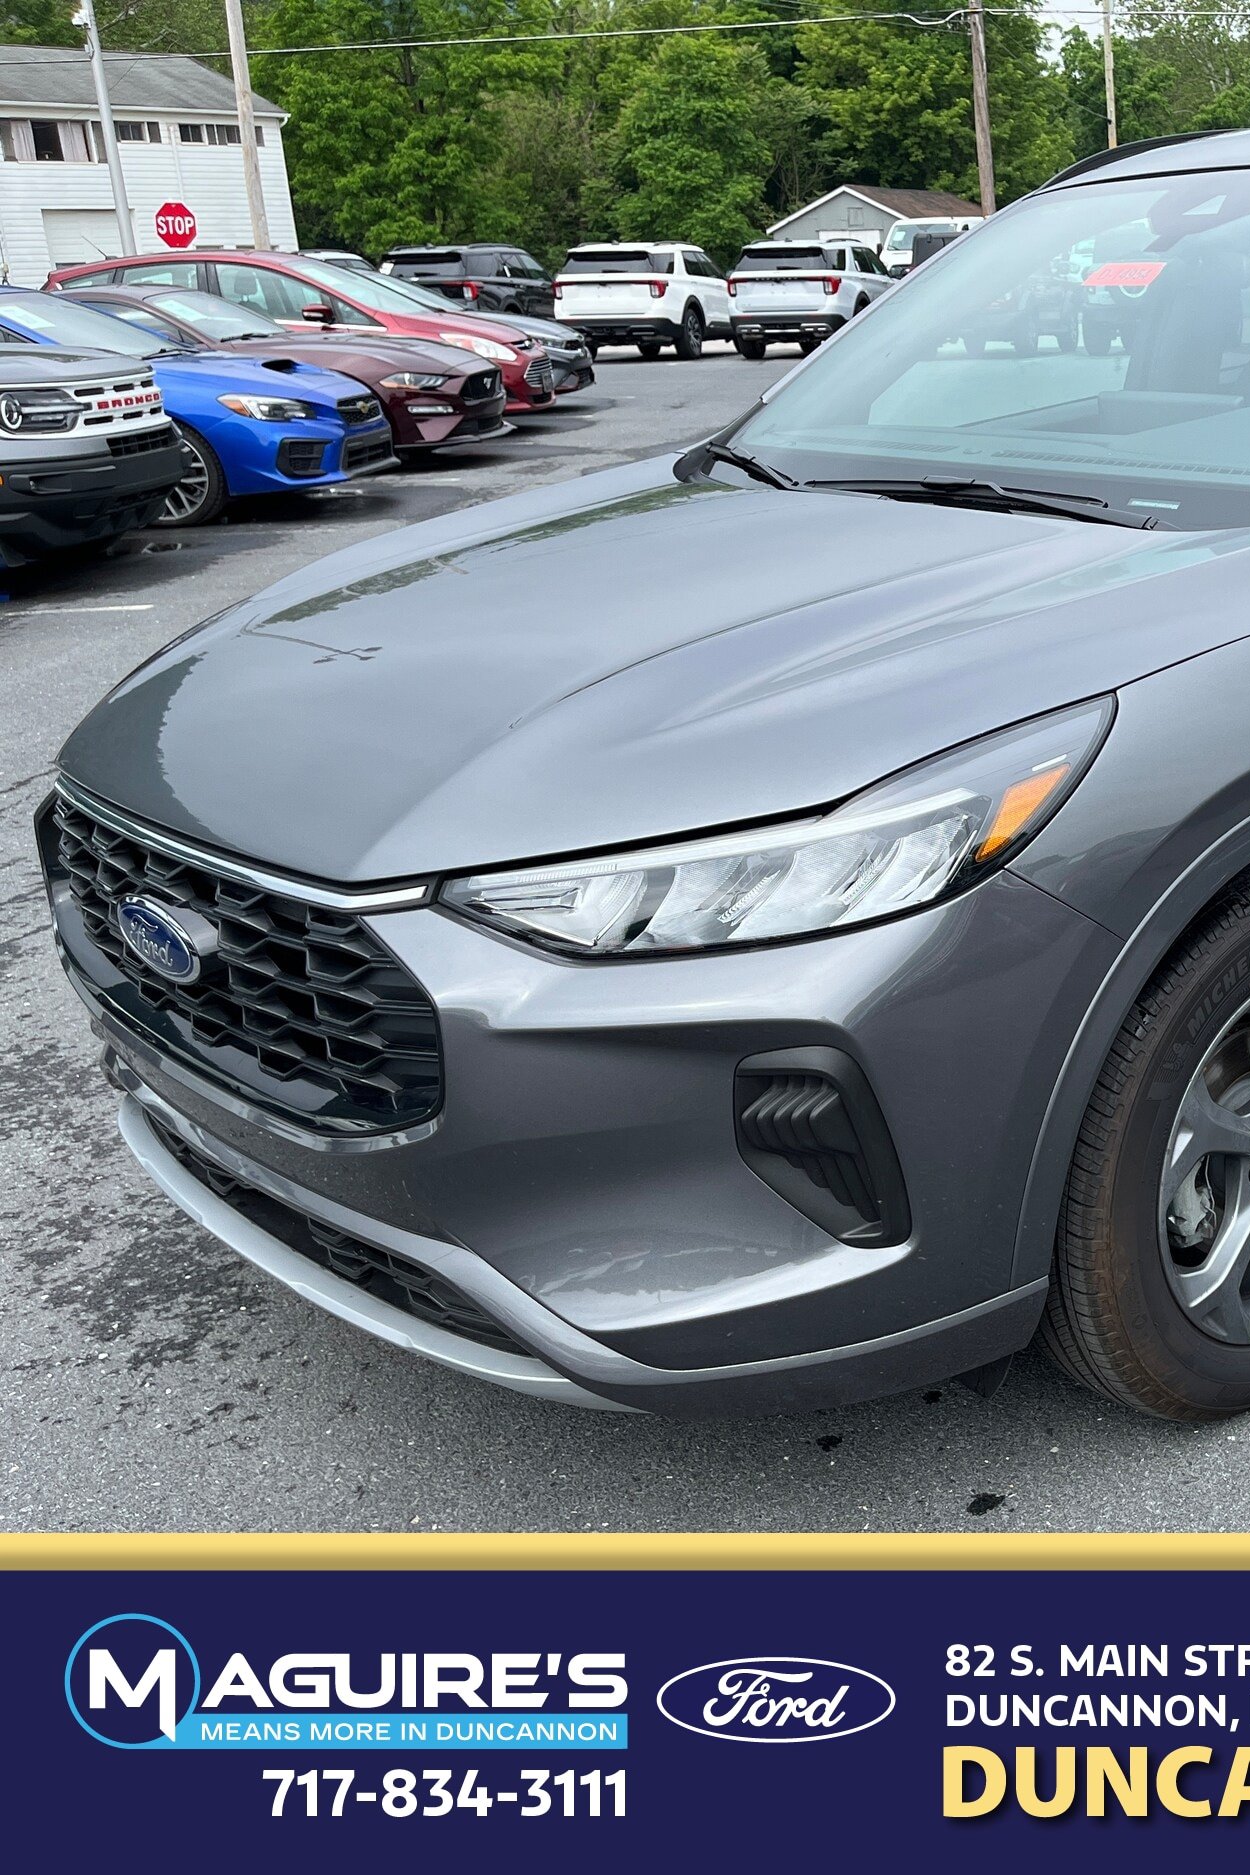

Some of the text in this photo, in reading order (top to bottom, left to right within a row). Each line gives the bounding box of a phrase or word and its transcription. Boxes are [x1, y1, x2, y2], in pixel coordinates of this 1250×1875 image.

[157, 215, 195, 235] STOP
[97, 393, 160, 409] BRONCO
[129, 913, 174, 967] Ford
